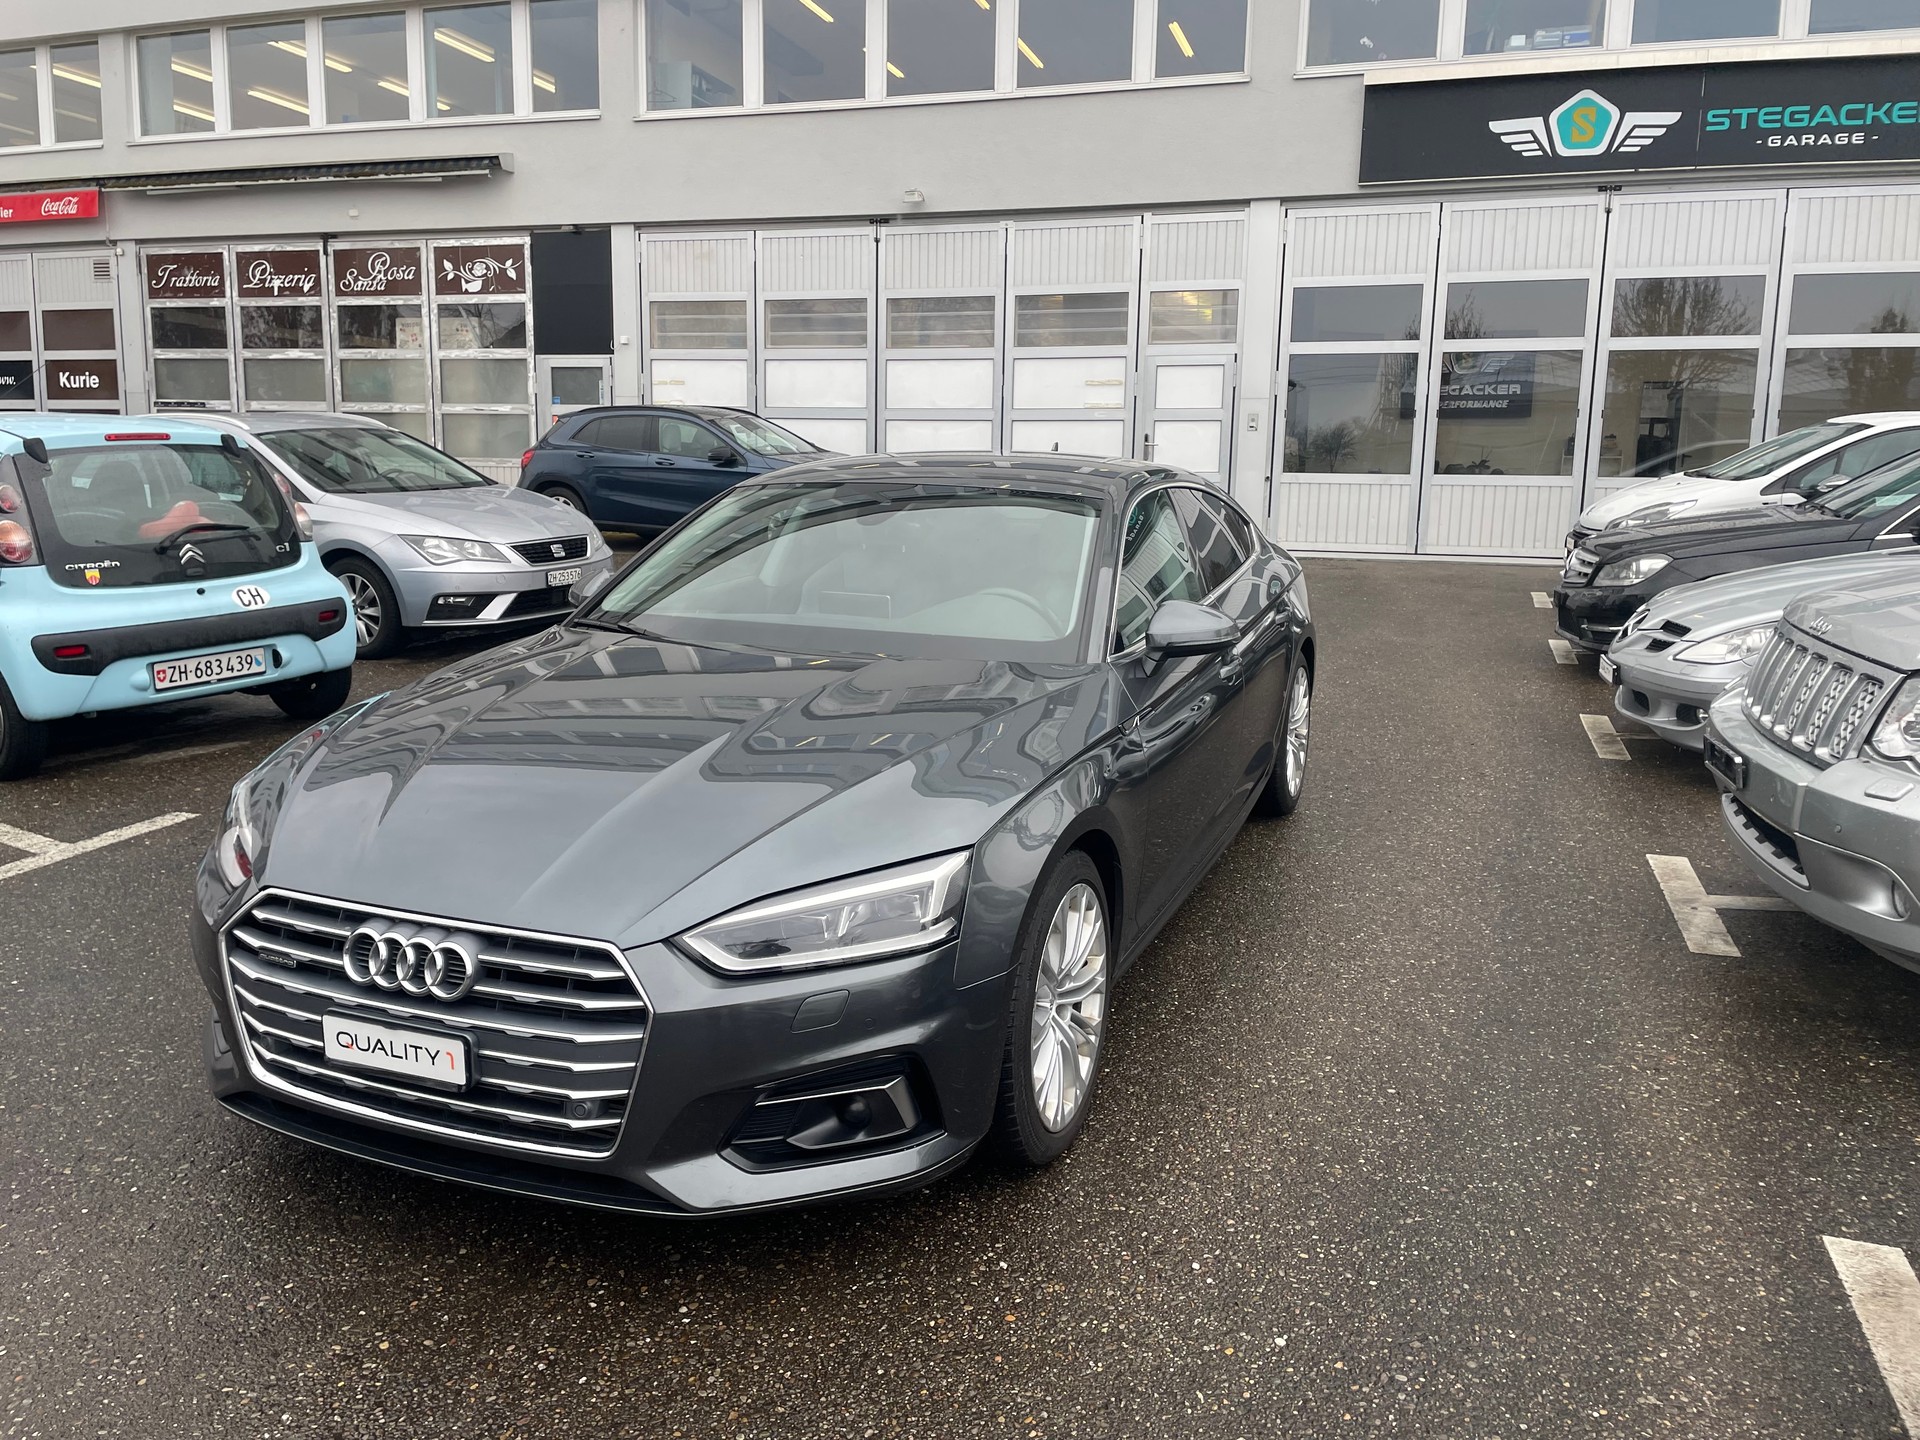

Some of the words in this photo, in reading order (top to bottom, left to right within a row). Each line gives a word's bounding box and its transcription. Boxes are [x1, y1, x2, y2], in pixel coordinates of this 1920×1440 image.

[1705, 101, 1920, 132] STEGACKE
[1767, 132, 1865, 148] GARAGE
[0, 207, 14, 219] ier
[151, 263, 221, 289] Trattoria
[243, 259, 316, 294] Pizzeria
[358, 251, 416, 283] Rosa
[339, 268, 388, 292] Santa
[59, 371, 100, 388] Kurie
[1440, 383, 1521, 396] EGACKER
[236, 587, 265, 607] CH
[336, 1031, 441, 1066] QUALITY
